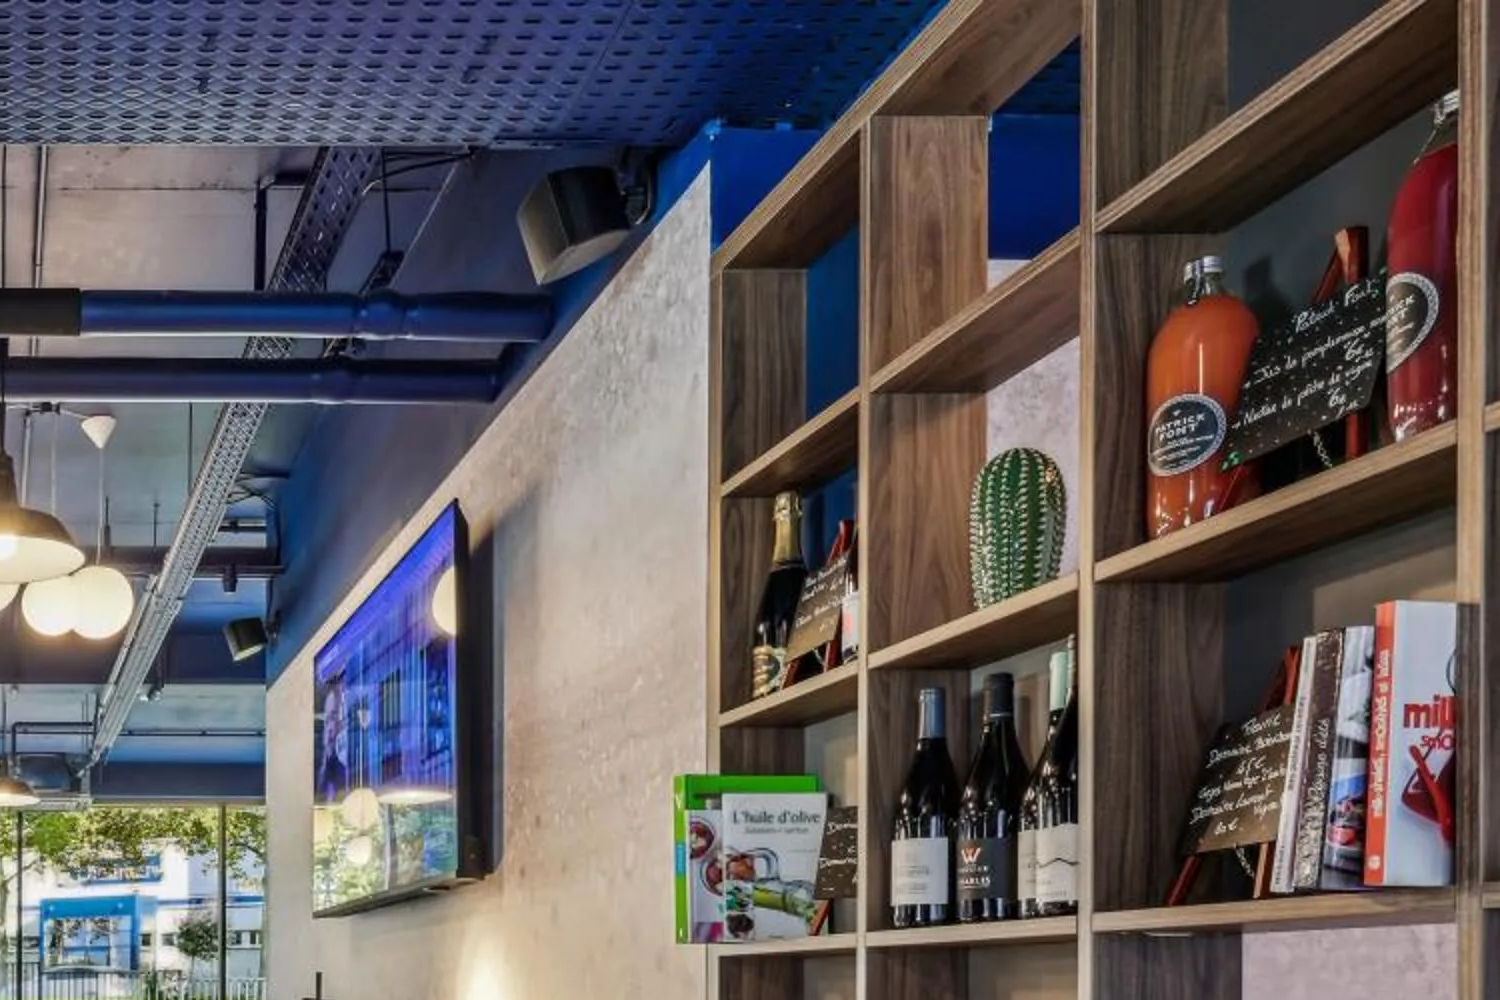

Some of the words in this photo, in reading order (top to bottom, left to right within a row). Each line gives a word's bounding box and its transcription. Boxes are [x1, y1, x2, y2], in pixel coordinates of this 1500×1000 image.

[1159, 423, 1197, 442] FONT
[733, 809, 772, 825] L'huile
[779, 809, 821, 825] d'olive
